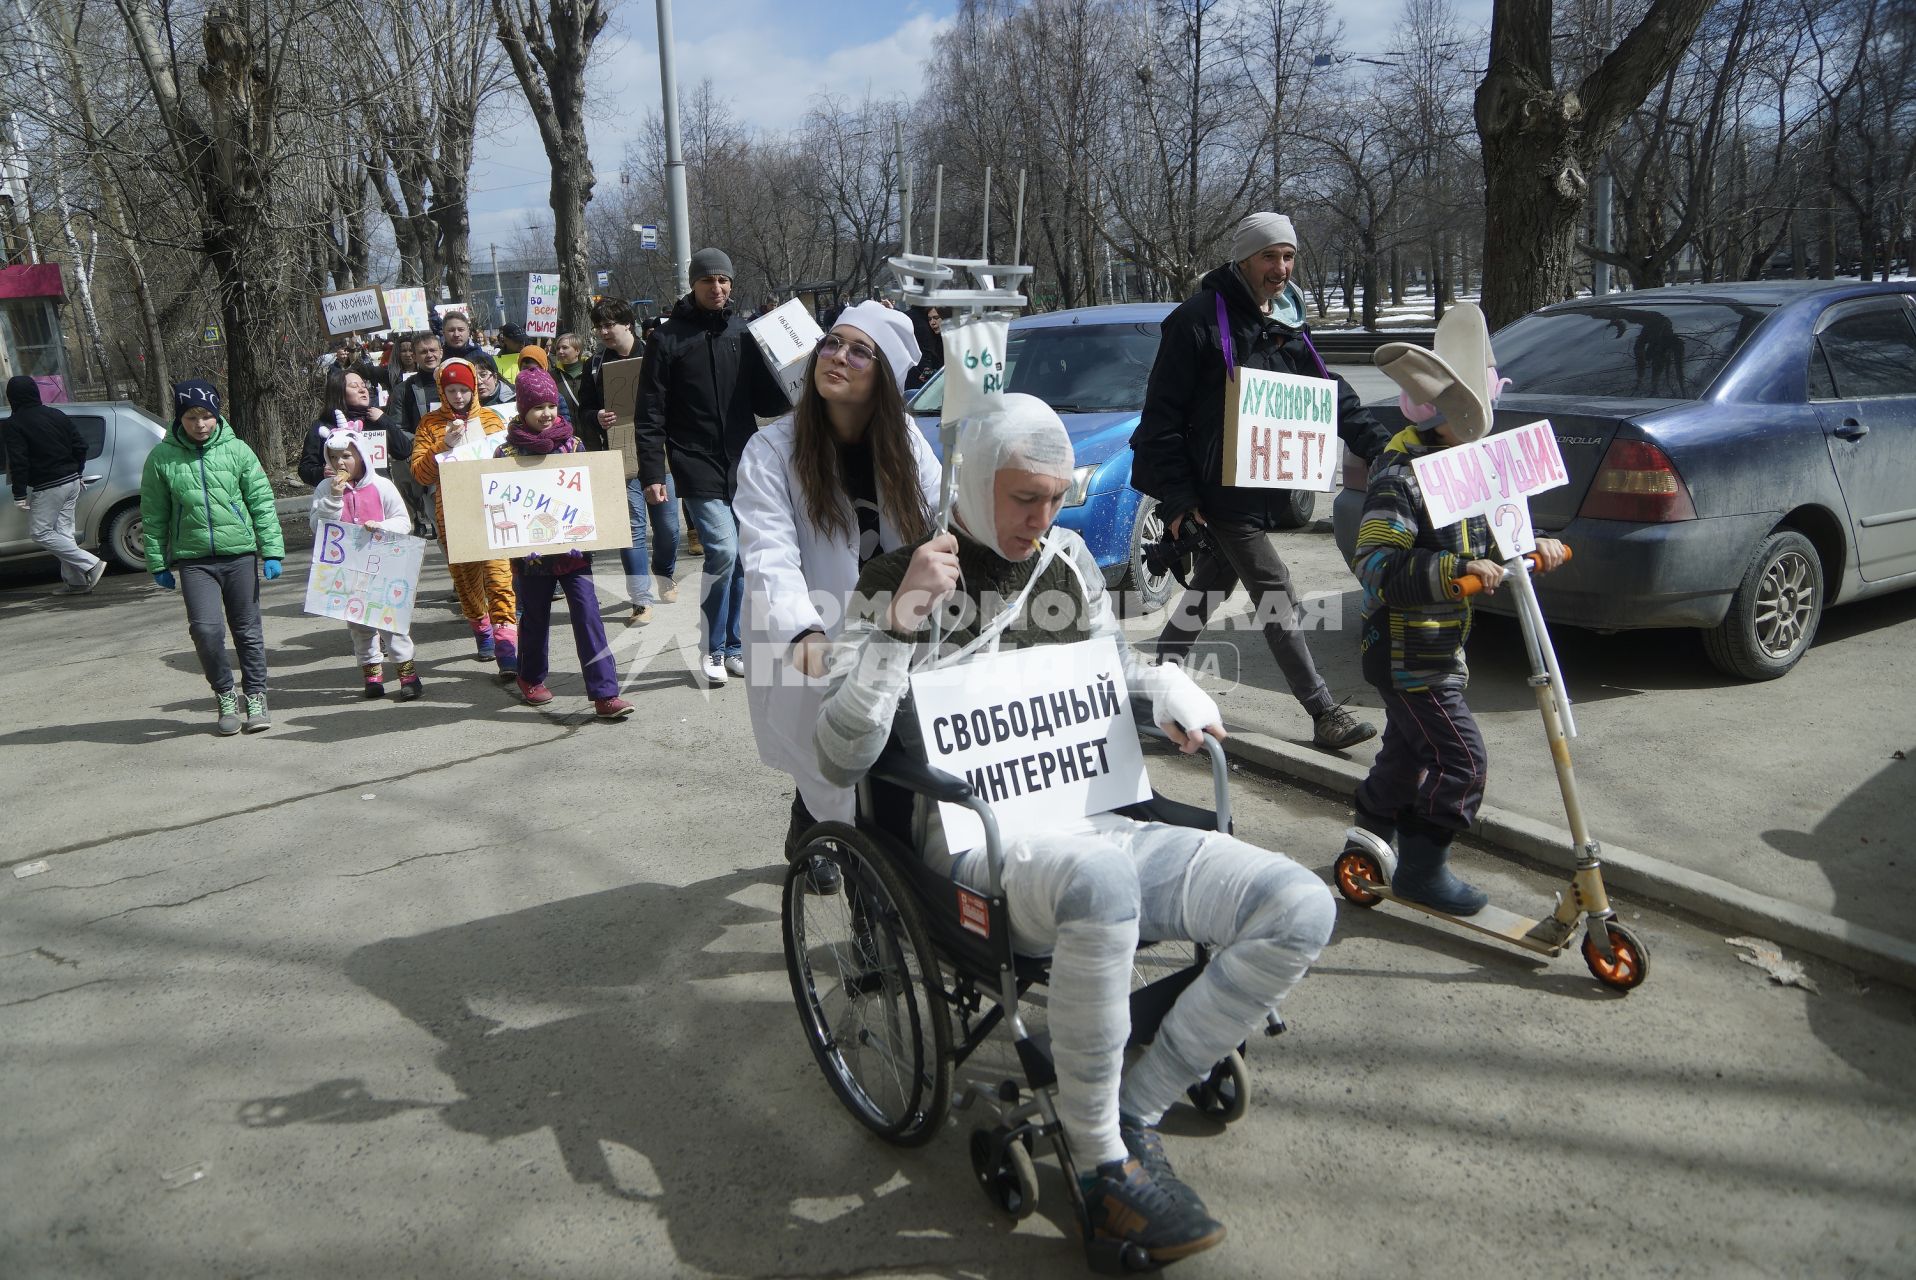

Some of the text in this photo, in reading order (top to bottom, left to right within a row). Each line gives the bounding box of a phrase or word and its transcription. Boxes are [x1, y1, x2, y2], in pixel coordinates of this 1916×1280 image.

[532, 275, 542, 283] ЗА
[325, 303, 337, 313] МЫ
[530, 296, 542, 305] ВО
[338, 312, 360, 326] НАМИ
[362, 308, 379, 321] МОХ
[178, 387, 220, 409] NYC
[1242, 377, 1333, 424] ЛУКОМОРЬЮ
[1554, 435, 1602, 445] OROLLA
[1250, 425, 1326, 481] НЕТ!
[1420, 424, 1563, 514] ЧЬИ УШИ!
[557, 469, 581, 492] ЗА
[933, 672, 1121, 755] СВОБОДНЫЙ
[966, 738, 1110, 804] ИНТЕРНЕТ
